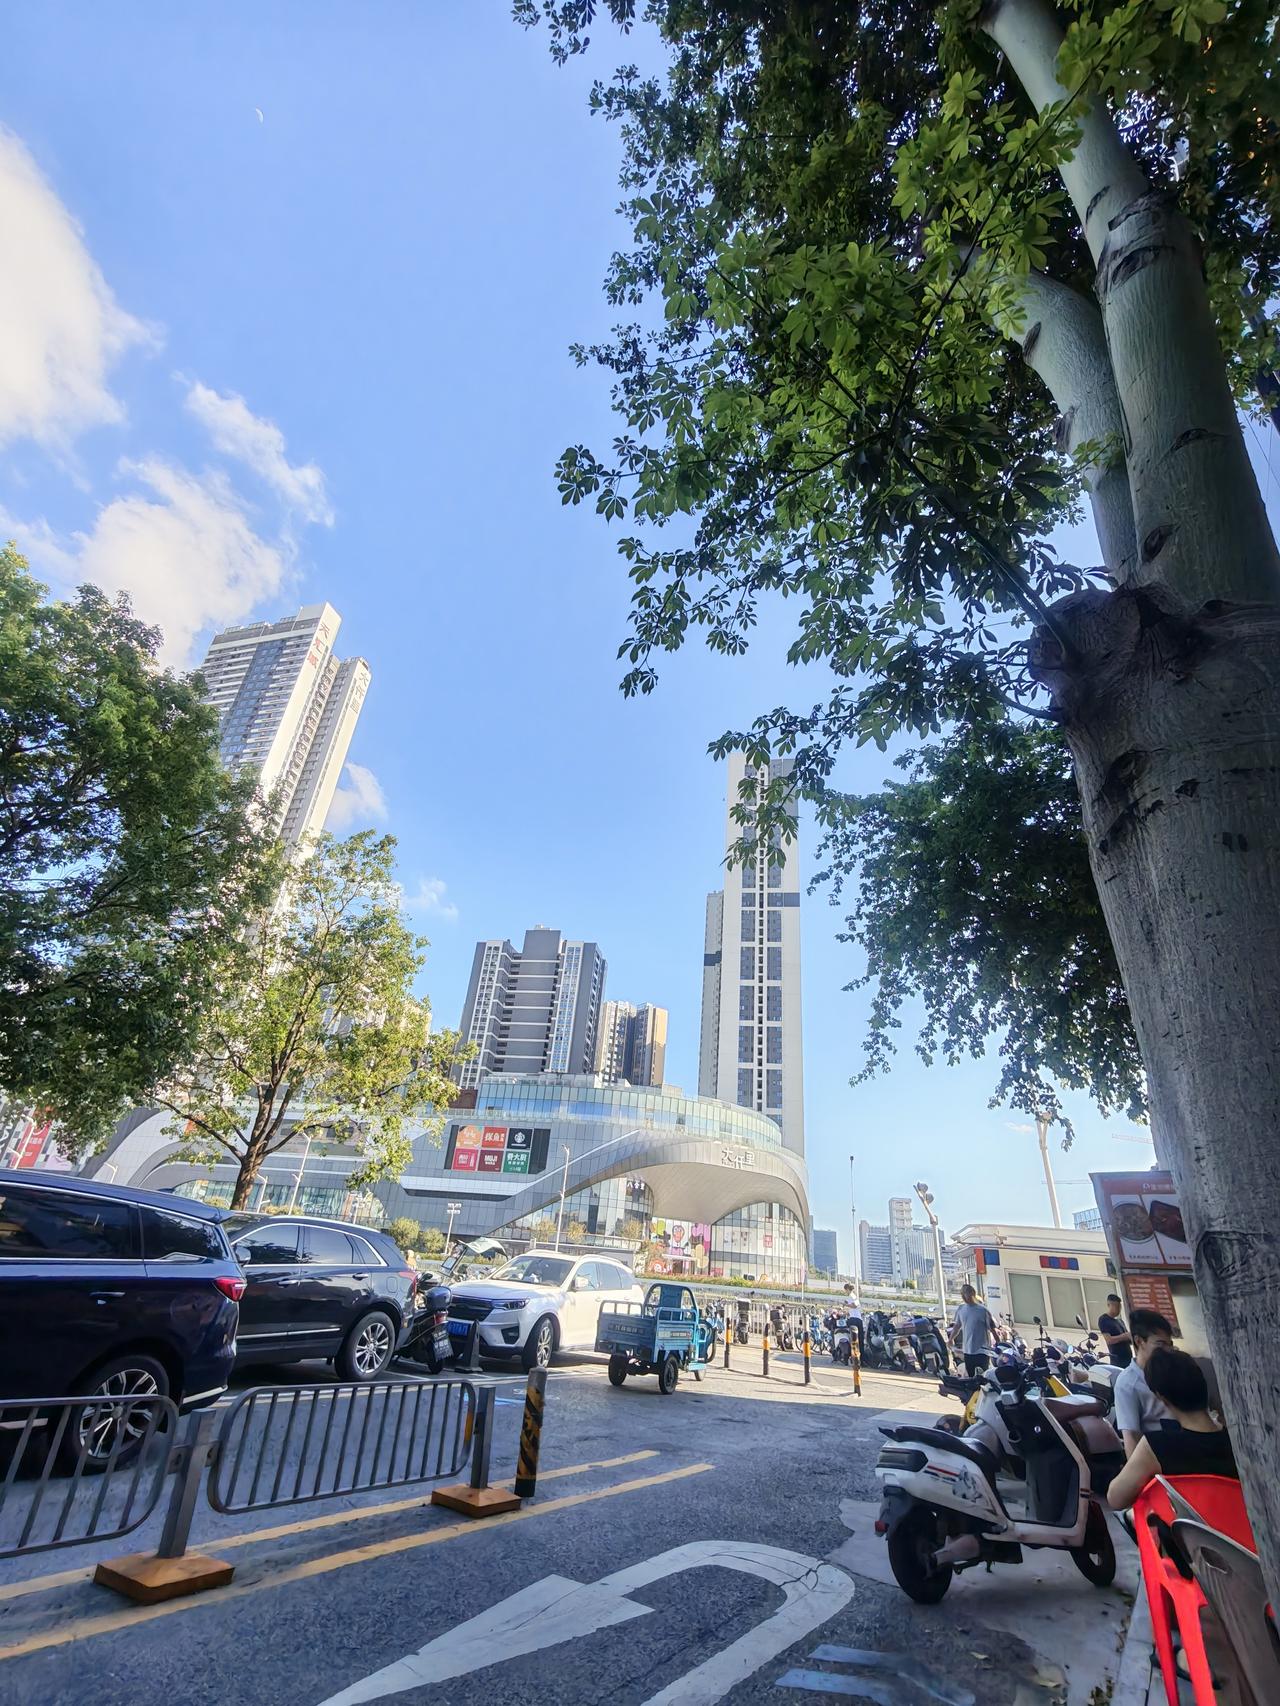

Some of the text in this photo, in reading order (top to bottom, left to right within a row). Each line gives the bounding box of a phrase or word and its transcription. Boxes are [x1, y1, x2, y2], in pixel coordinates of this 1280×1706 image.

[484, 1154, 498, 1162] MUJI
[721, 1147, 755, 1169] 大仟里
